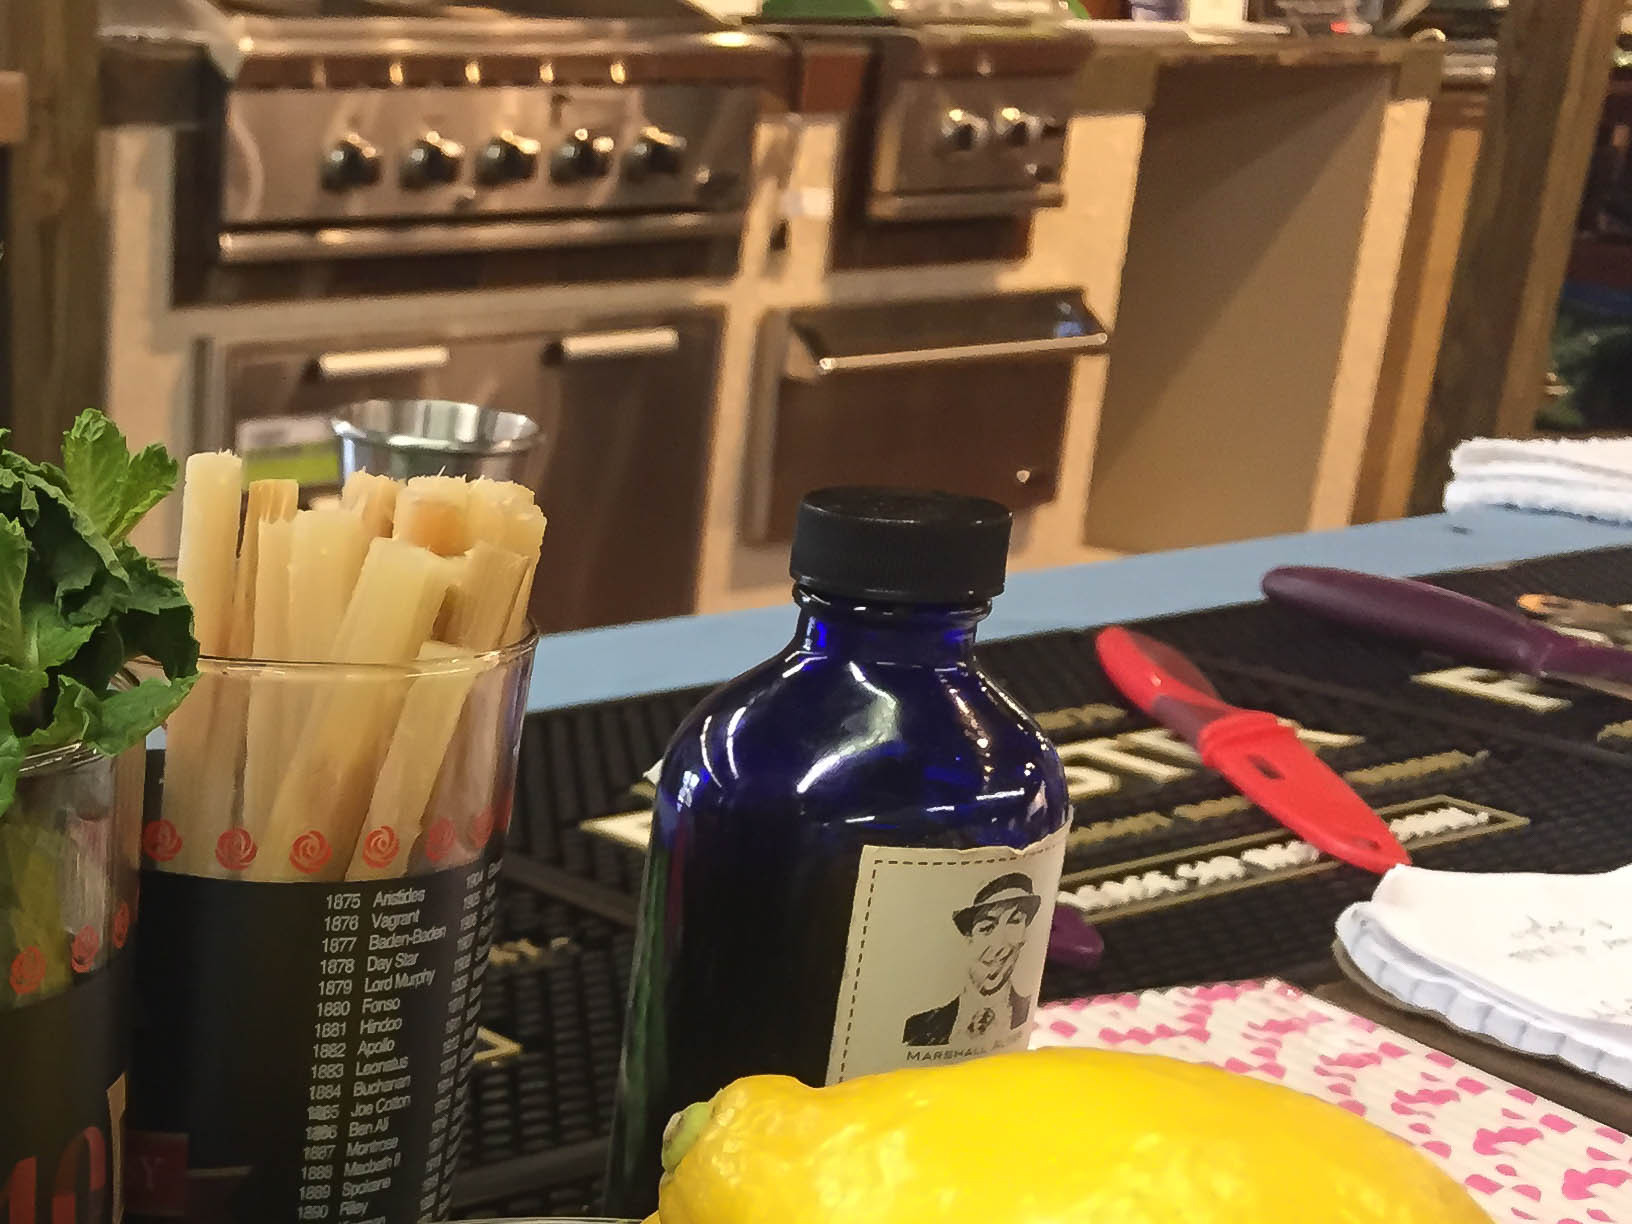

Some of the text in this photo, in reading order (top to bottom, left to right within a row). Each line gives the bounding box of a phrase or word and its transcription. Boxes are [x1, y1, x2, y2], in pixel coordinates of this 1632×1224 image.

[326, 887, 426, 910] 1875 Aristides
[324, 910, 420, 932] 1876 Vagrant
[322, 925, 447, 953] 1877 Baden-Baden
[320, 952, 419, 976] 1878 Day Star
[318, 968, 436, 996] 1879 Lord Murphy
[316, 998, 401, 1017] 1880 Fonso
[314, 1018, 403, 1039] 1881 Hindoo
[313, 1037, 396, 1059] 1882 Apollo
[312, 1063, 344, 1079] 1883
[350, 1103, 373, 1117] Joe
